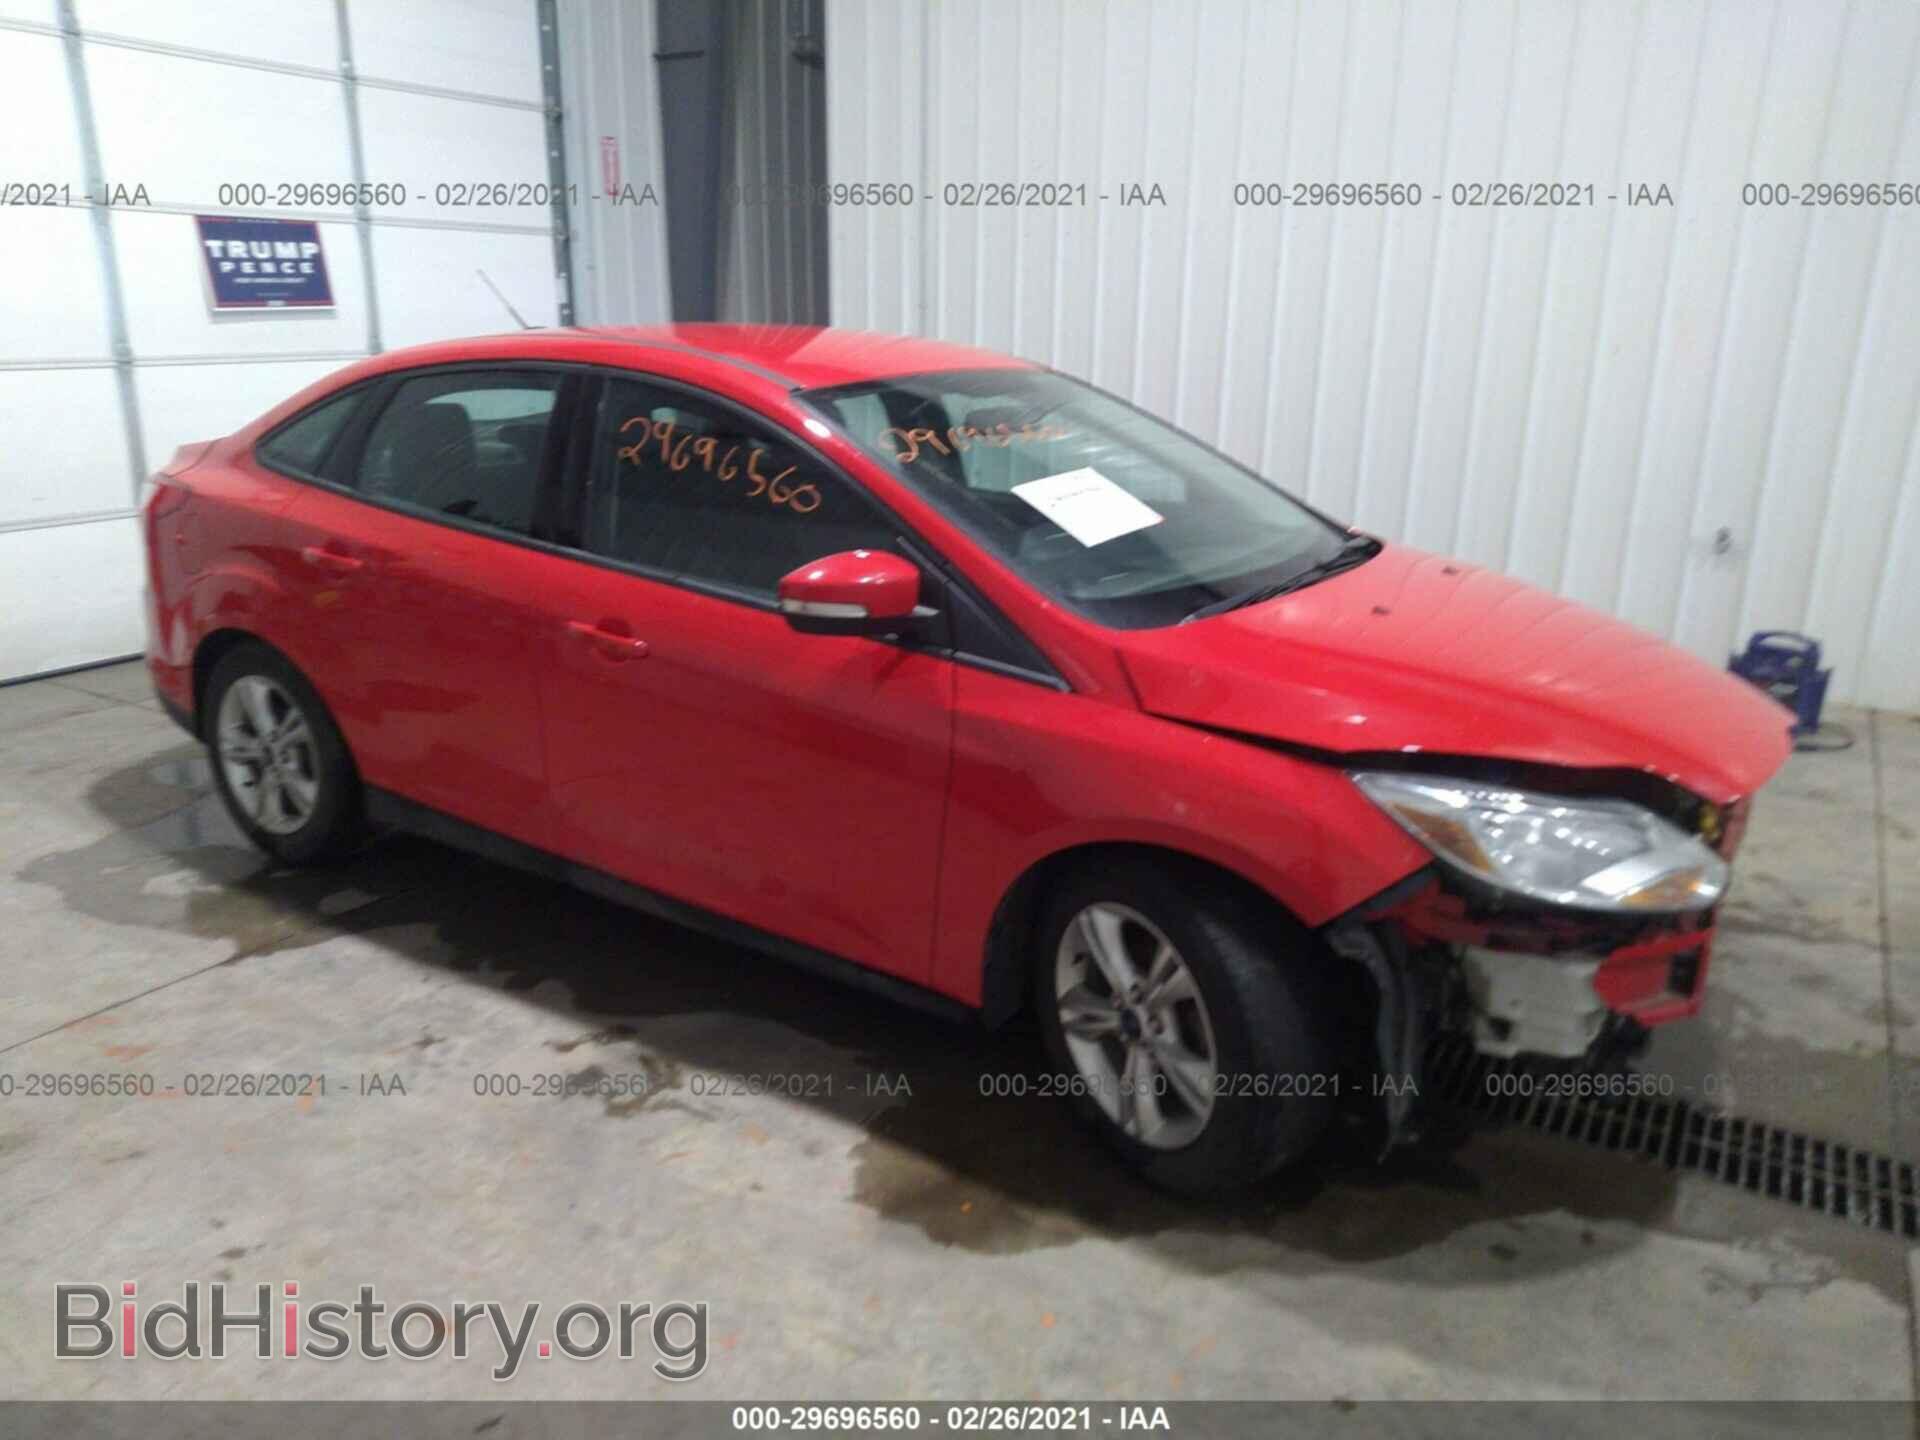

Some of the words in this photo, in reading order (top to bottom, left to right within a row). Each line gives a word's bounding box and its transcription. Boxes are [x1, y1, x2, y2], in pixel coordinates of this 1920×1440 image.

[205, 239, 319, 259] TRUMP
[218, 261, 315, 274] PENCE
[616, 416, 822, 513] 29696560
